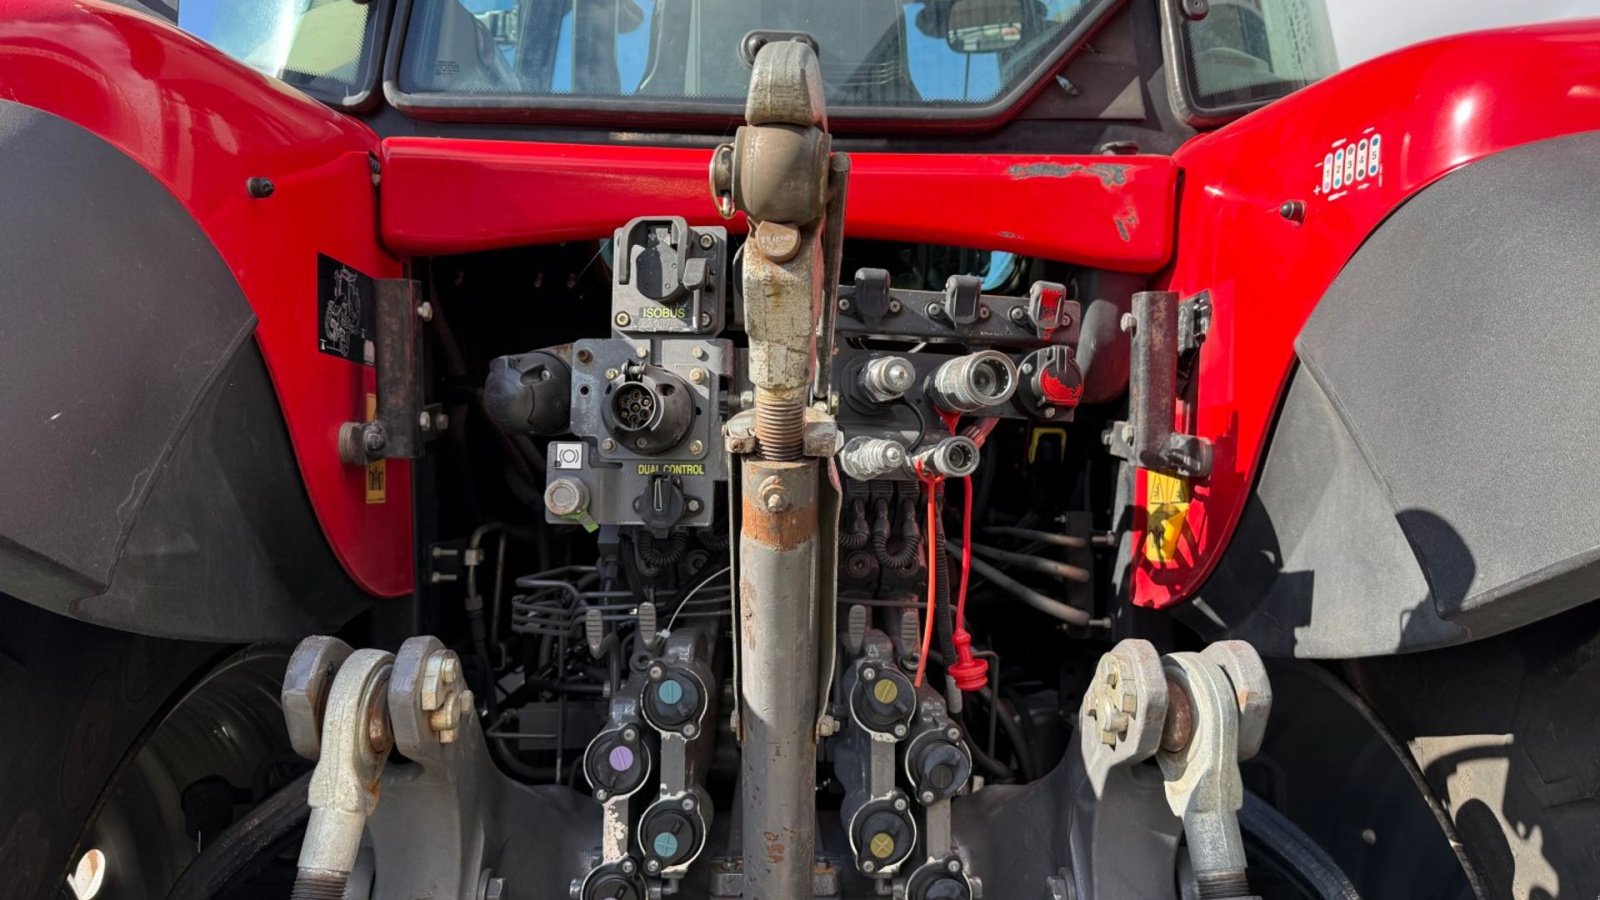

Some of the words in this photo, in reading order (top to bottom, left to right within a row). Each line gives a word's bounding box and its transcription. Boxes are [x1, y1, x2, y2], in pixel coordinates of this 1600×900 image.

[643, 307, 686, 318] ISOBUS
[638, 464, 659, 475] DUAL
[663, 464, 705, 475] CONTROL
